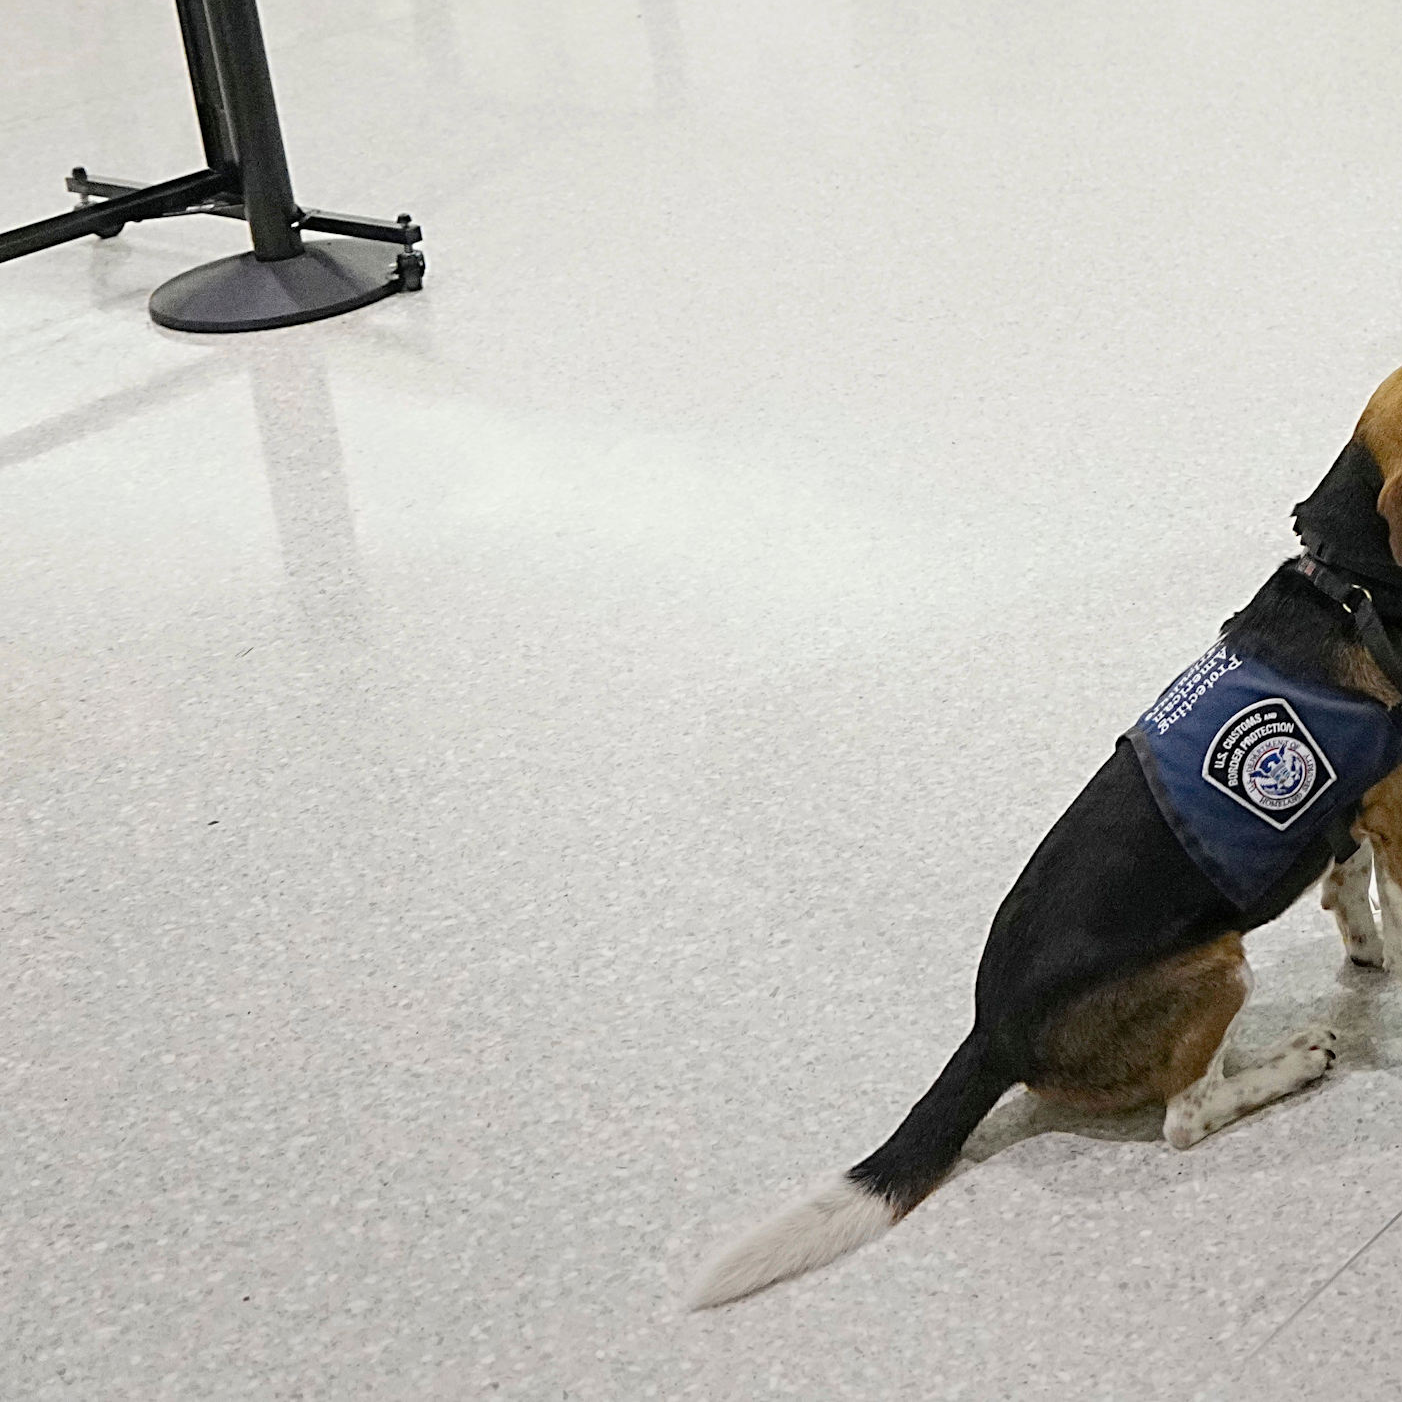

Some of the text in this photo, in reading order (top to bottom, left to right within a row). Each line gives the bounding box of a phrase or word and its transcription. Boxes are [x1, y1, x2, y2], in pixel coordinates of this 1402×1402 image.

[1152, 645, 1227, 723] American
[1157, 653, 1243, 736] Protecting
[1213, 711, 1278, 769] U.S. CUSTOMS AND
[1227, 722, 1295, 787] BORDER PROTECTION
[1258, 793, 1303, 808] HOMELAND
